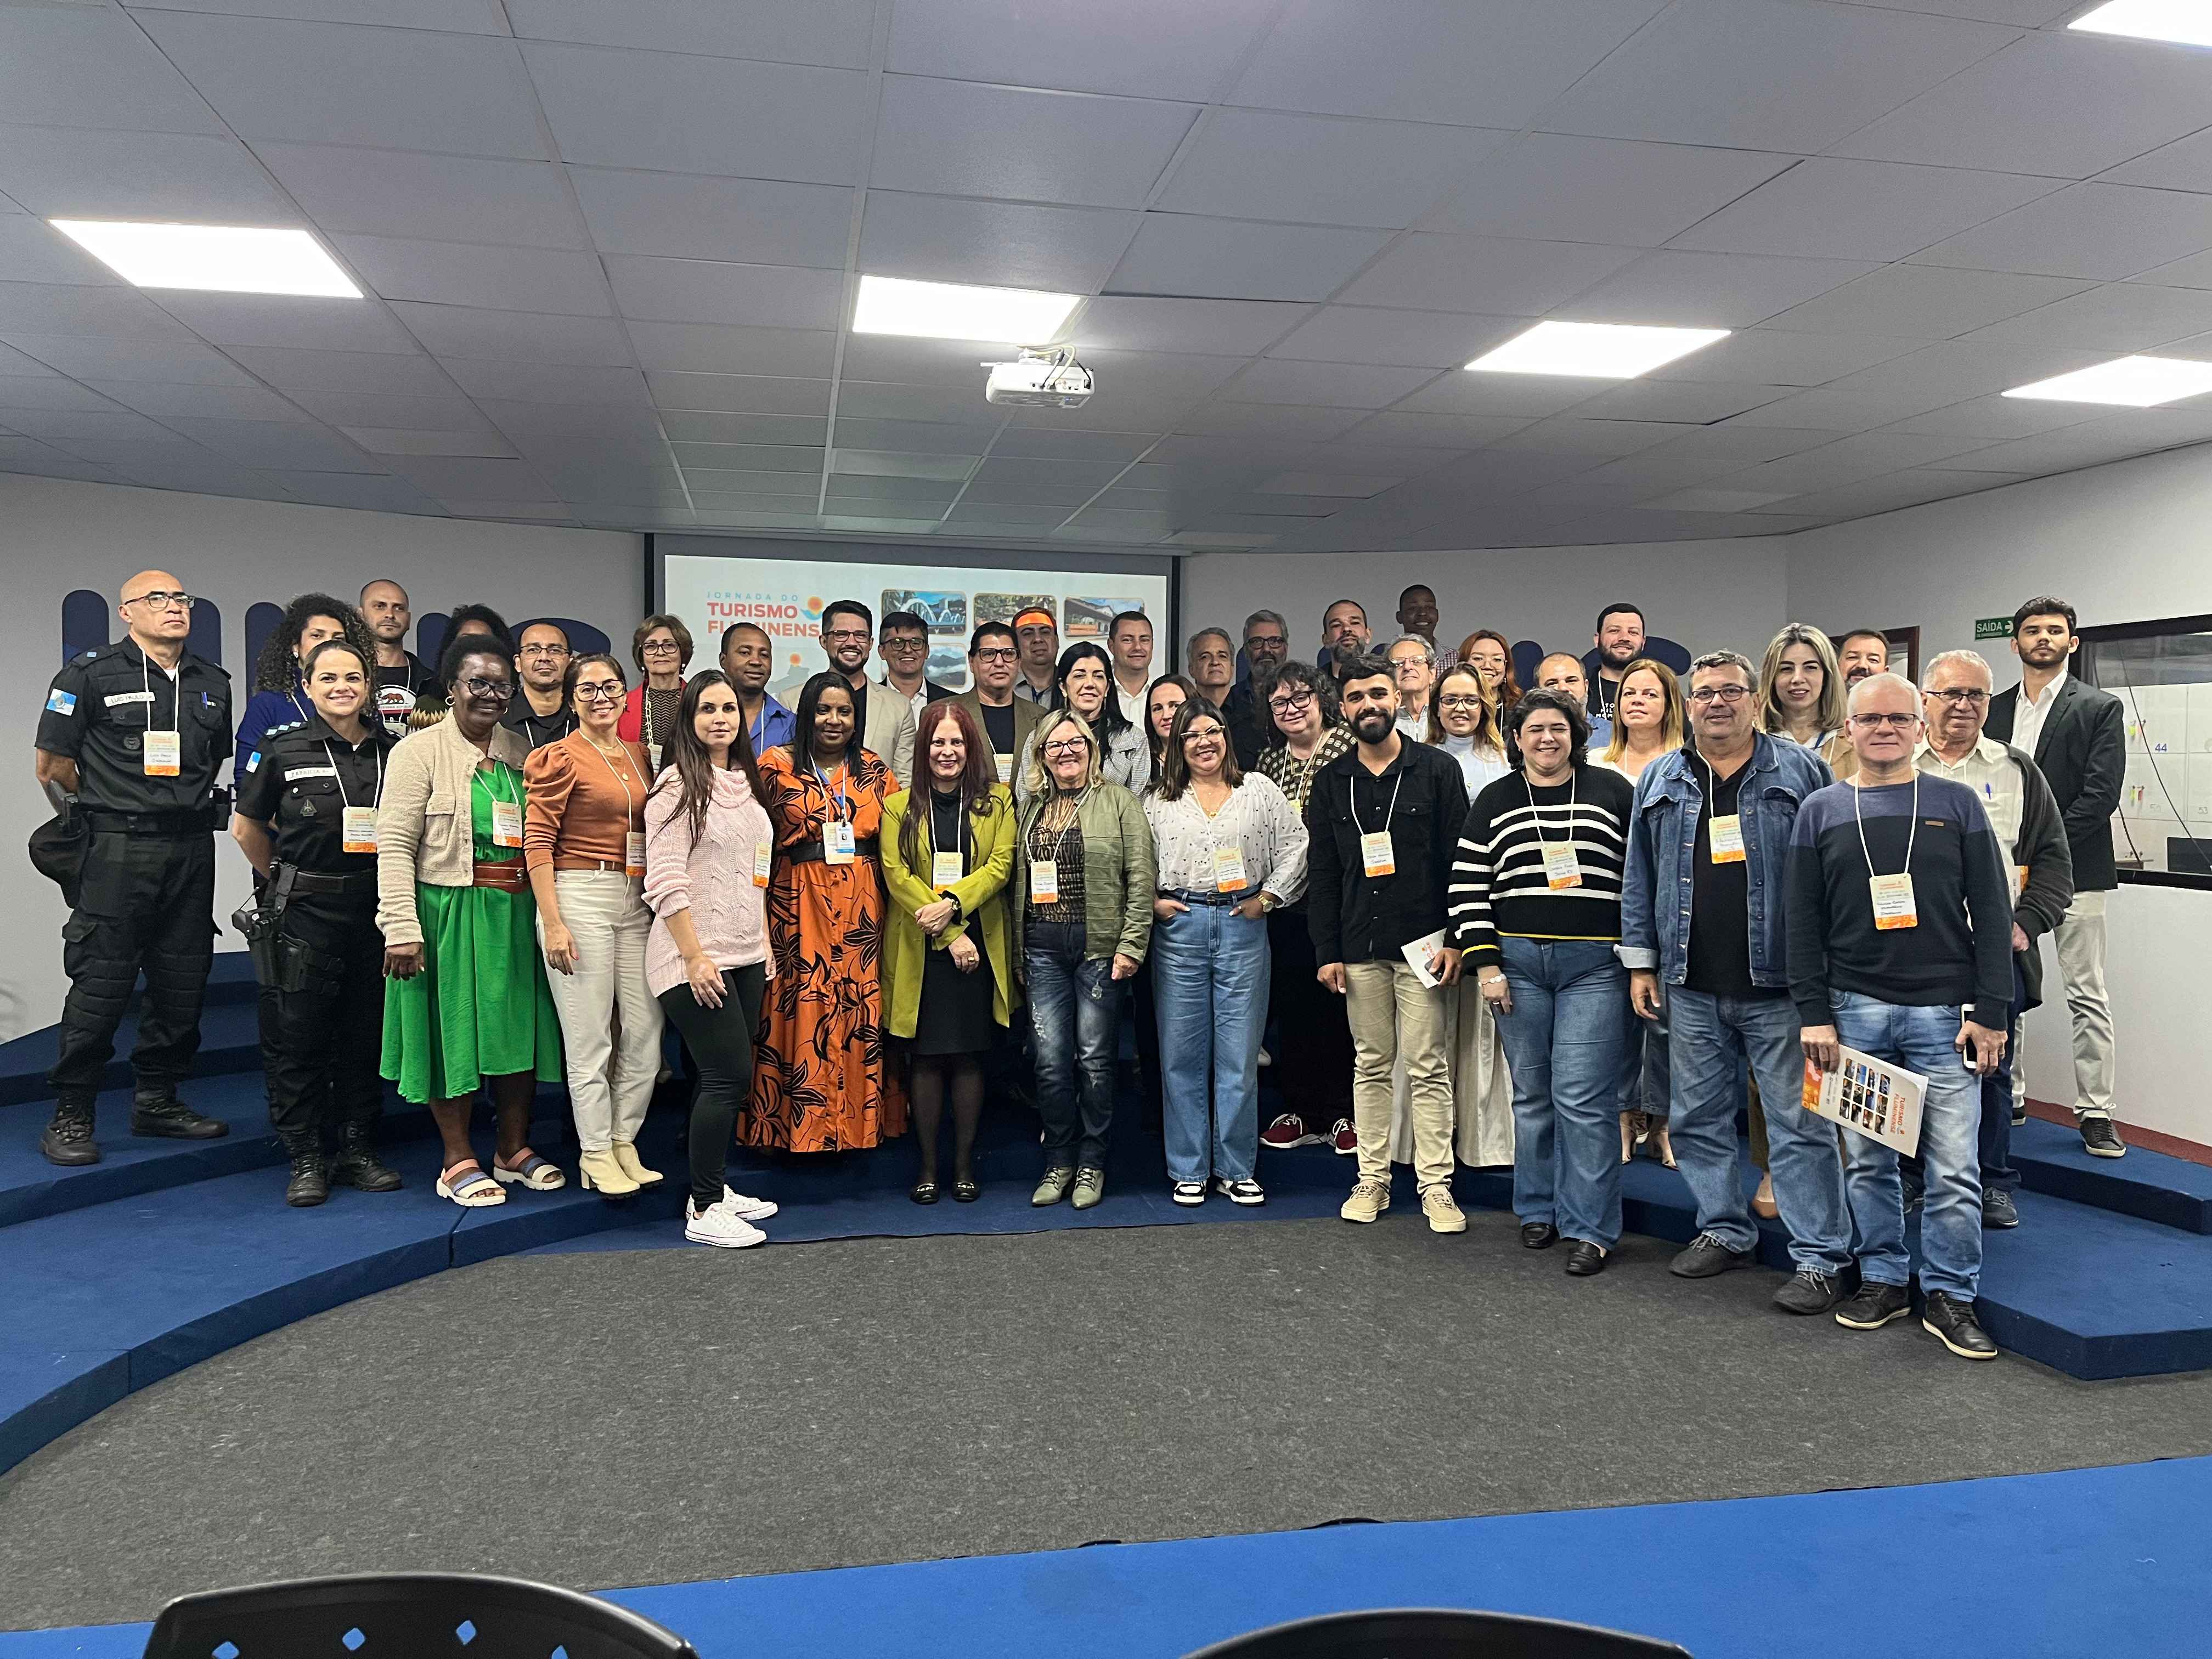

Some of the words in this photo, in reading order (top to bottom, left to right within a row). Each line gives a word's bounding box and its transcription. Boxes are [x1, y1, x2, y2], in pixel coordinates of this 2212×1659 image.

[707, 591, 772, 601] JORNADA
[707, 602, 798, 619] TURISMO
[1977, 620, 2002, 633] SAÍDA
[2154, 743, 2168, 752] 44
